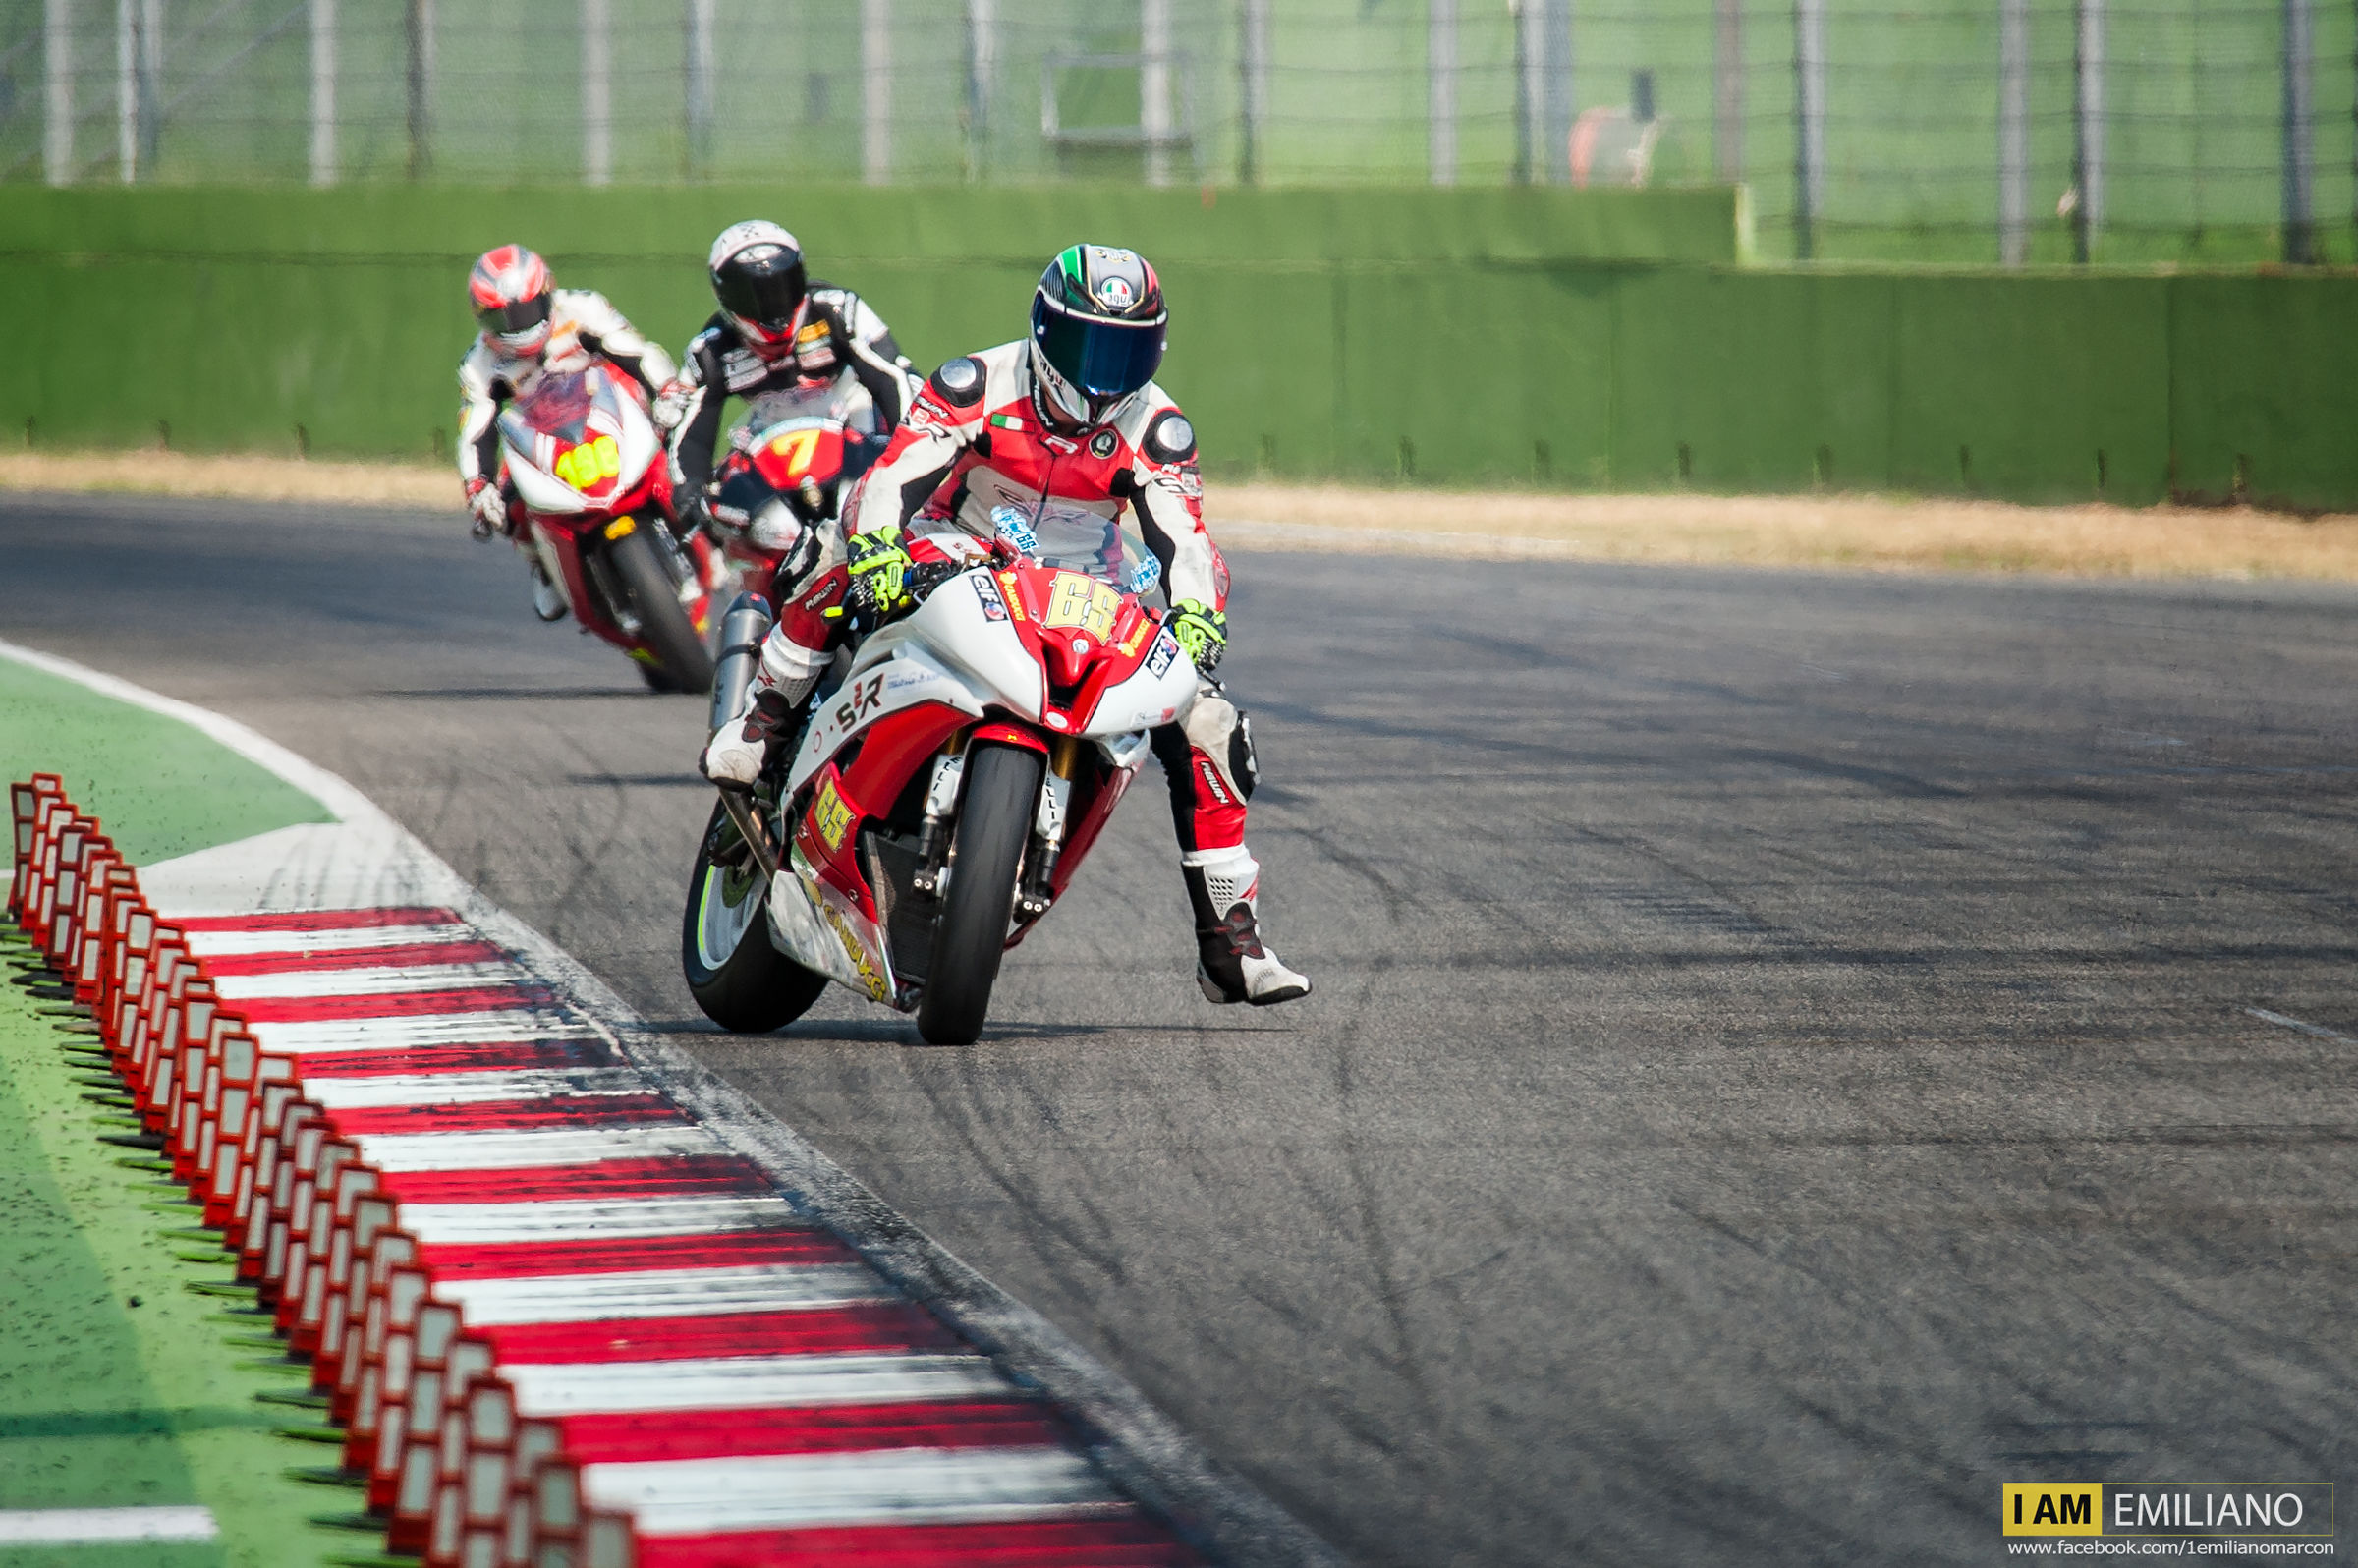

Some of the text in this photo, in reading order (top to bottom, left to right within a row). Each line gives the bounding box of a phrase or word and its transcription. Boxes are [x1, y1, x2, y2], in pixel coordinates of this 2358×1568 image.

[772, 429, 822, 478] 7
[973, 575, 1000, 603] elf
[1149, 648, 1171, 675] elf
